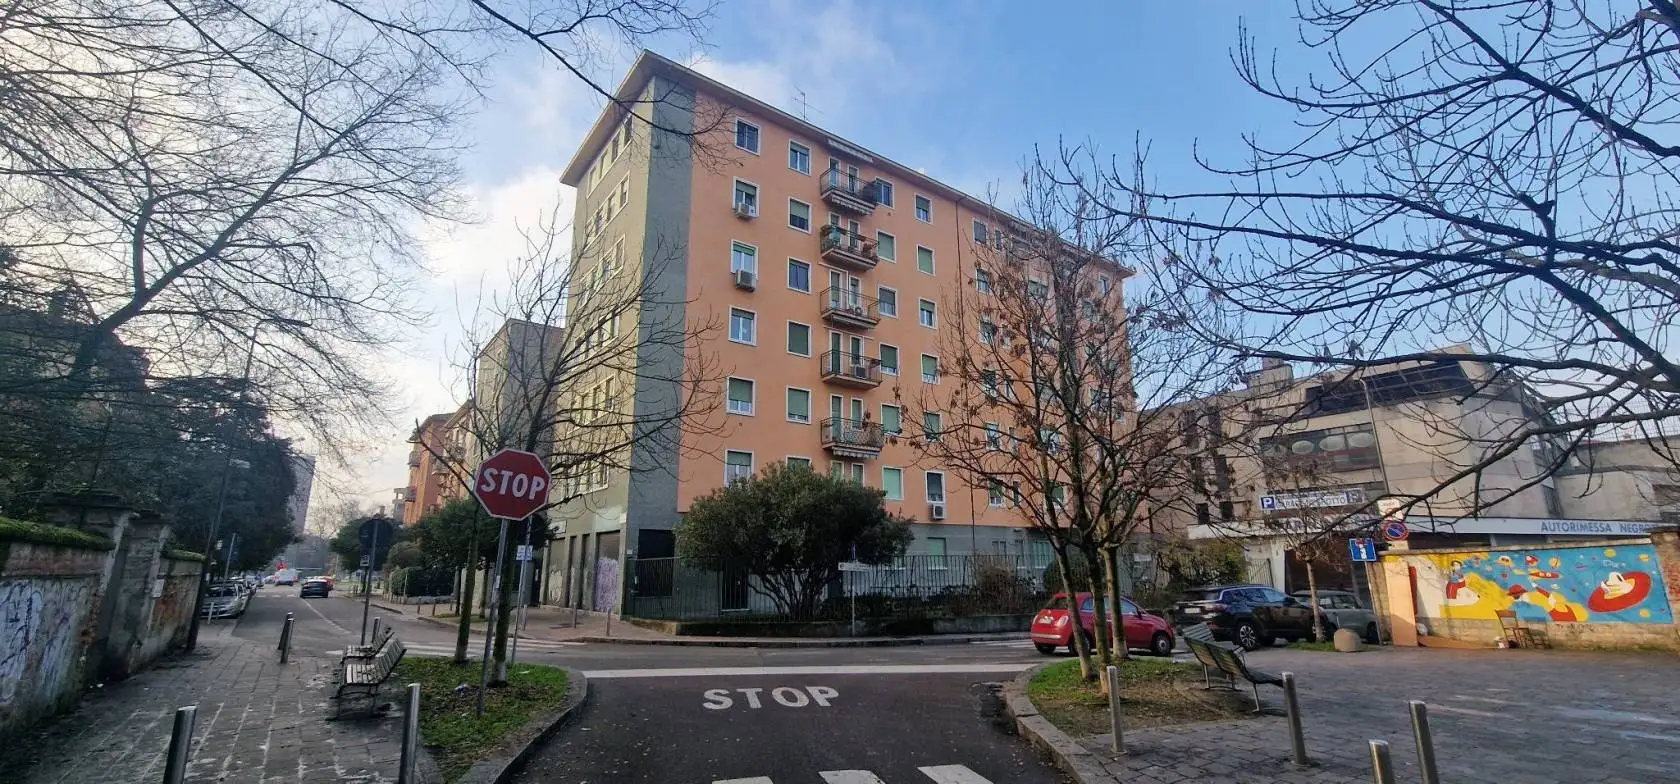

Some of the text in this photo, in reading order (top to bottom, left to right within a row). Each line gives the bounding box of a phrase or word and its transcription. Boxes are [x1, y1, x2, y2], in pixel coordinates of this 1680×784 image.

[481, 467, 545, 500] STOP
[1263, 497, 1273, 508] P
[1541, 520, 1659, 533] AUTORIMESSA NEGRO
[702, 685, 839, 710] STOP
